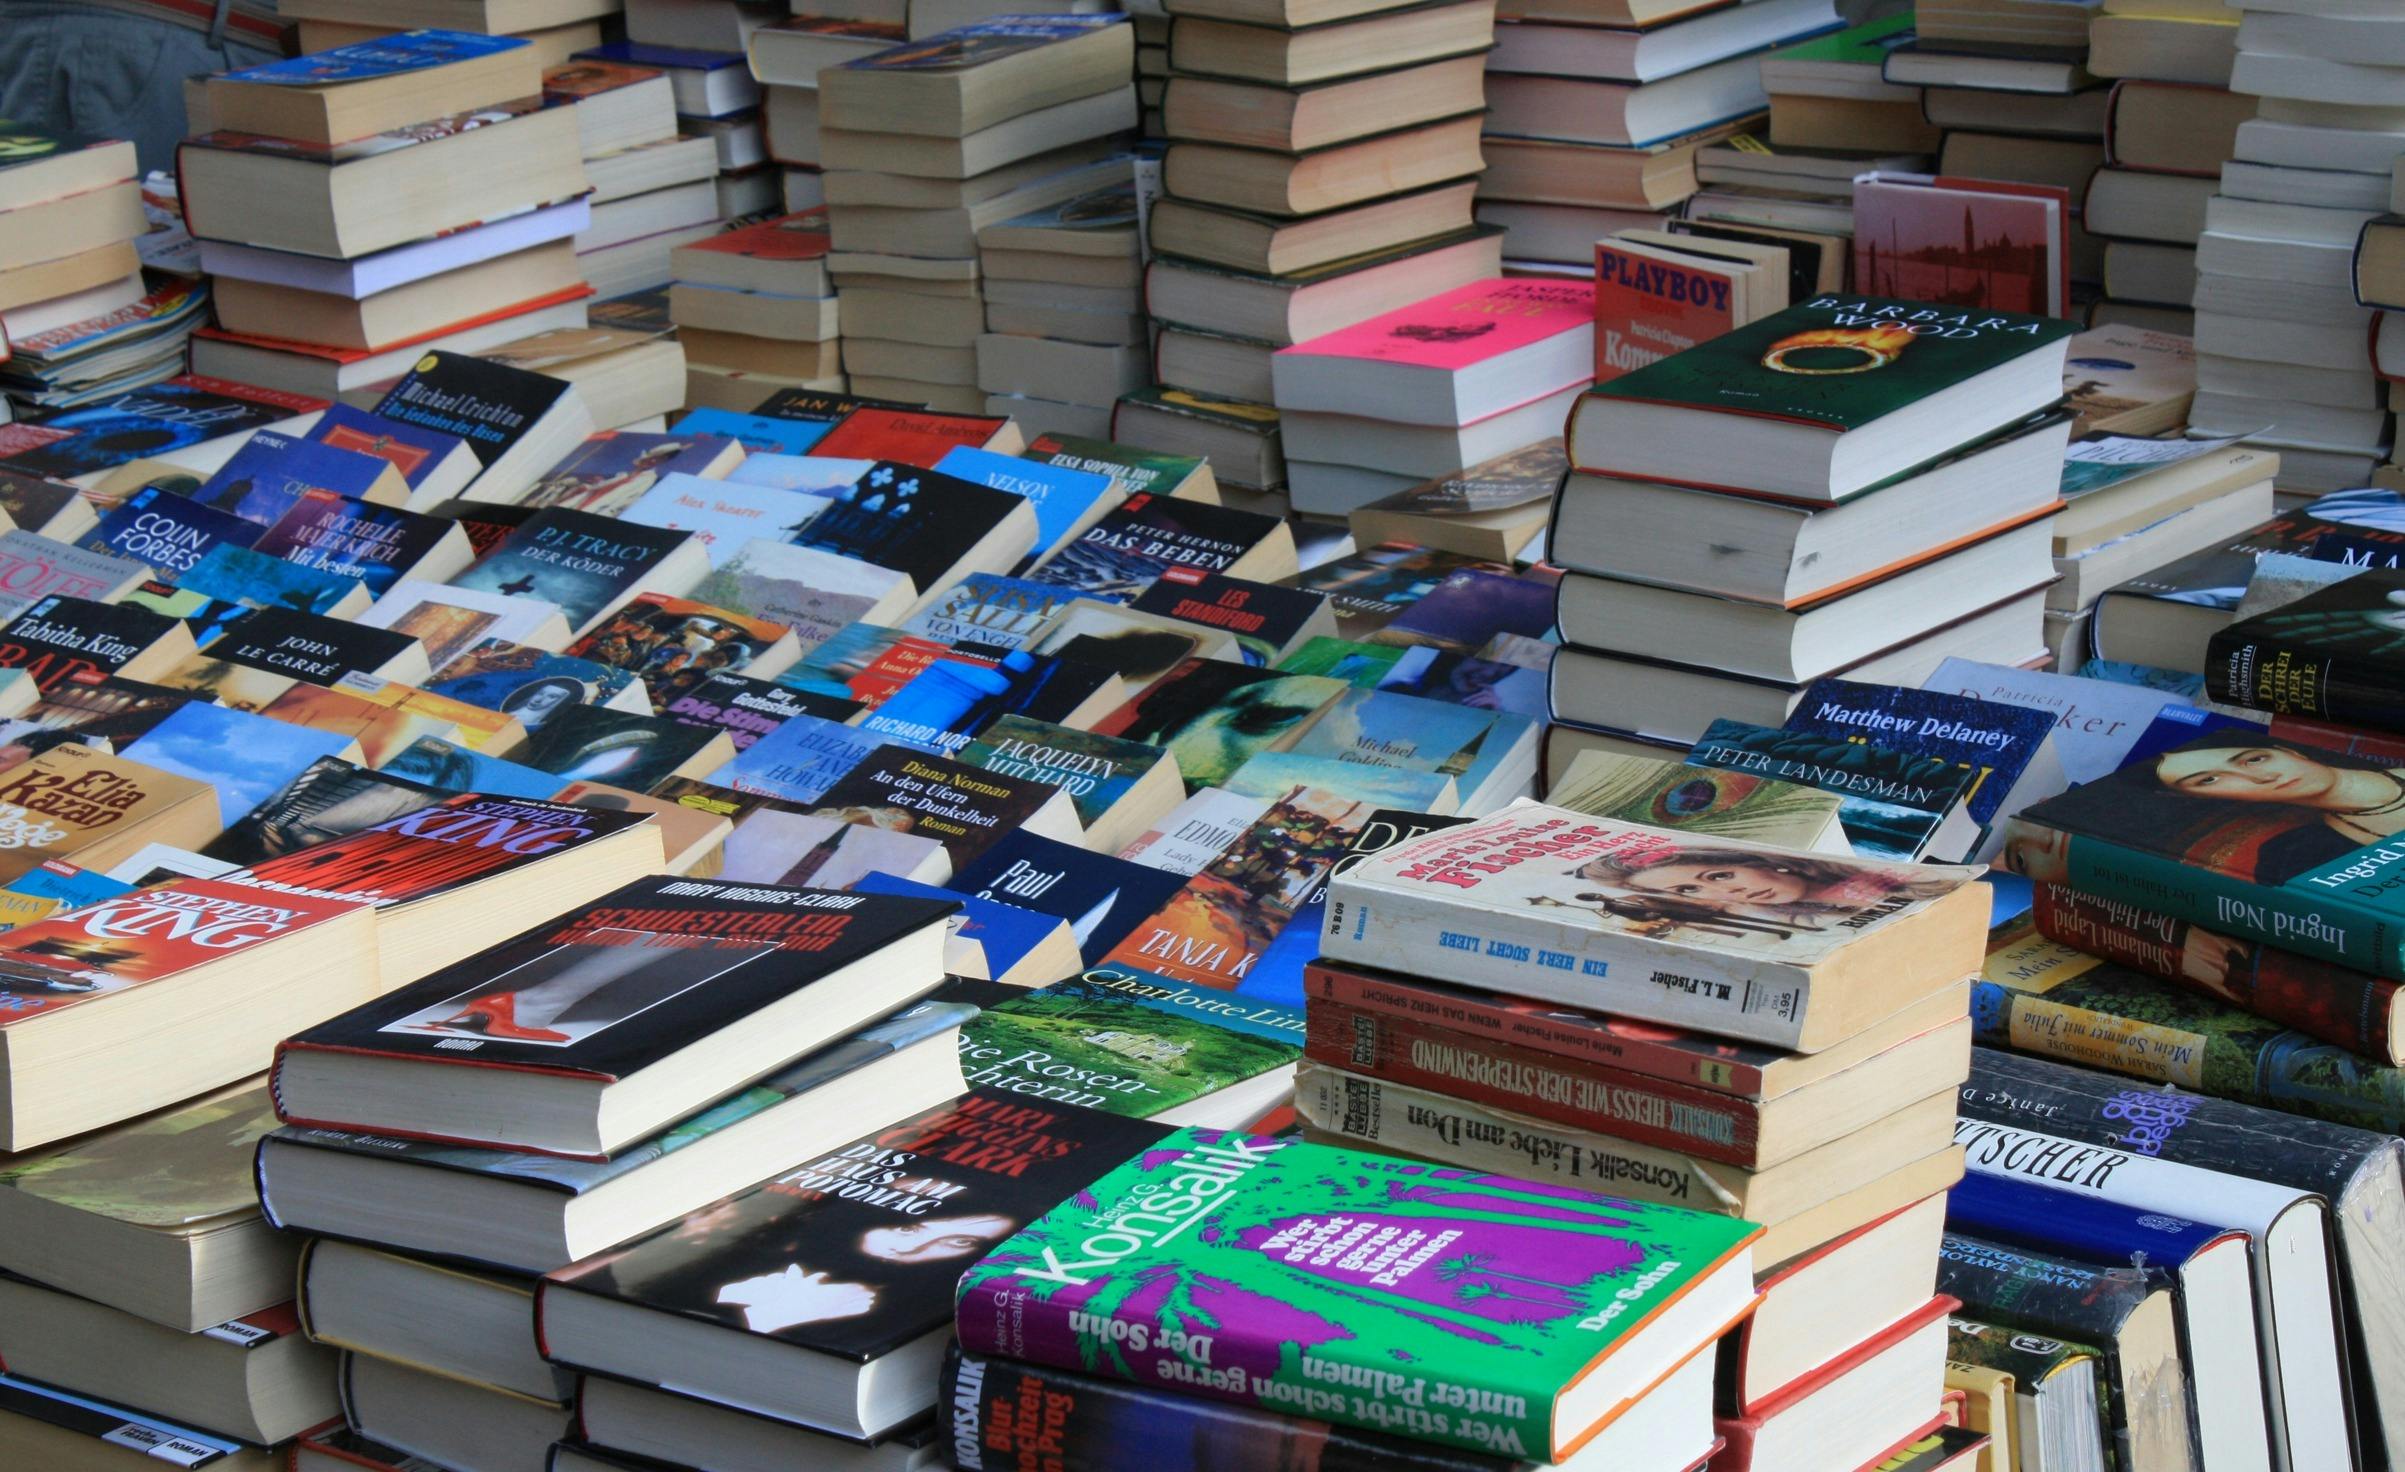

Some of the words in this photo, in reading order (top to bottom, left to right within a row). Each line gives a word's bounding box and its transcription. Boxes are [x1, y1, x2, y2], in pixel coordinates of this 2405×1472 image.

[1601, 251, 1729, 311] PLAYBOY
[1807, 298, 2041, 335] BARBARA
[1833, 314, 1980, 340] WOOD
[401, 381, 466, 411] Michael
[458, 396, 524, 428] Crichton
[783, 396, 827, 409] JAN
[1049, 453, 1082, 470] ELSA
[1128, 466, 1160, 482] VON
[982, 472, 1055, 501] NELSON
[135, 512, 210, 550] COLIN
[317, 511, 405, 545] ROCHELLE
[1126, 523, 1176, 541] PETER
[1179, 532, 1245, 554] HERNON
[112, 528, 203, 571] FORBES
[520, 546, 557, 562] DER
[560, 552, 626, 578] KÖDER
[572, 534, 658, 562] TRACY
[1082, 528, 1136, 551] DAS
[1142, 540, 1234, 570] BEBEN
[1171, 600, 1266, 632] STANDIFORD
[1216, 588, 1250, 607] LES
[10, 617, 87, 649] Tabitha
[81, 633, 138, 663] King
[276, 635, 339, 657] JOHN
[236, 644, 259, 659] LE
[265, 650, 341, 677] CARRÉ
[2228, 651, 2240, 697] Patricia
[767, 688, 797, 704] Gary
[2259, 662, 2274, 700] DER
[2275, 651, 2292, 714] SCHREI
[2289, 668, 2302, 704] DER
[2302, 663, 2318, 712] EULE
[668, 697, 717, 720] Die
[1813, 701, 1919, 737] Matthew
[1924, 718, 2016, 752] Delaney
[866, 715, 937, 742] RICHARD
[1352, 735, 1419, 759] Michael
[981, 756, 1096, 798] MITCHARD
[990, 738, 1122, 780] JACQUELYN
[1702, 744, 1774, 770] PETER
[1779, 761, 1935, 805] LANDESMAN
[53, 770, 146, 810] Elia
[870, 769, 888, 783] An
[892, 773, 921, 789] den
[925, 783, 969, 805] Ufern
[902, 760, 946, 784] Diana
[949, 773, 1011, 799] Norman
[0, 769, 124, 831] Kazan
[463, 802, 597, 826] STEPHEN
[887, 790, 915, 808] der
[916, 799, 1000, 830] Dunkelheit
[365, 808, 594, 855] KING
[918, 816, 967, 836] Roman
[1163, 848, 1196, 864] Lady
[1396, 843, 1487, 881] Marie
[1478, 818, 1570, 849] Louise
[1426, 825, 1611, 889] Fischer
[2309, 848, 2404, 888] Ingrid
[657, 881, 723, 898] MARY
[715, 887, 866, 910] HIGGINS-CLARK
[990, 860, 1066, 900] Paul
[48, 898, 292, 948] KING
[143, 890, 308, 925] STEPHEN
[1353, 906, 1368, 941] Roman
[1838, 897, 1913, 929] ROMAN
[2217, 895, 2266, 932] Noll
[1331, 923, 1341, 935] 76
[1440, 930, 1480, 953] LIEBE
[2053, 908, 2096, 945] Lapid
[2145, 913, 2177, 944] Der
[2273, 911, 2347, 955] Ingrid
[1137, 928, 1231, 972] TANJA
[1486, 940, 1532, 962] SUCHT
[1537, 952, 1576, 971] HERZ
[1582, 960, 1609, 977] EIN
[2008, 956, 2057, 981] Mein
[2099, 926, 2173, 975] Shulamit
[1361, 988, 1407, 1010] SPRICHT
[1650, 970, 1698, 994] Fischer
[1082, 969, 1243, 1022] Charlotte
[1241, 1004, 1307, 1034] Lin
[1410, 999, 1440, 1016] HERZ
[1443, 1007, 1464, 1021] DAS
[1777, 992, 1792, 1018] 3,95
[1468, 1014, 1501, 1030] WENN
[1513, 1022, 1552, 1042] Fischer
[1553, 1031, 1590, 1048] Louise
[2022, 1010, 2061, 1037] Julia
[2062, 1023, 2087, 1044] mit
[2089, 1025, 2149, 1056] Sommer
[1592, 1040, 1623, 1057] Marie
[2045, 1038, 2124, 1067] WOODHOUSE
[2125, 1053, 2167, 1076] SARAH
[2151, 1038, 2194, 1065] Mein
[999, 1050, 1161, 1095] Rosen-
[1411, 1039, 1535, 1098] STEPPENWIND
[1537, 1069, 1572, 1103] DER
[955, 1095, 1067, 1132] MARY
[1575, 1079, 1608, 1113] WIE
[1613, 1090, 1665, 1127] HEISS
[1984, 1091, 2059, 1117] Janice
[912, 1110, 1083, 1160] HIGGINS
[1408, 1104, 1461, 1147] Don
[1466, 1118, 1505, 1146] am
[1670, 1102, 1734, 1145] KONSALIK
[842, 1143, 916, 1168] DAS
[875, 1126, 1036, 1178] CLARK
[1511, 1131, 1582, 1180] Liebe
[786, 1171, 942, 1216] POTOMAC
[817, 1157, 905, 1187] HAUS
[900, 1178, 967, 1202] AM
[1589, 1155, 1688, 1201] Konsalik
[1014, 1137, 1288, 1287] Konsalik
[1084, 1190, 1143, 1232] Heinz
[1132, 1180, 1165, 1201] G.
[1259, 1218, 1318, 1250] Wer
[1284, 1216, 1354, 1263] stirbt
[1309, 1222, 1379, 1266] schon
[1336, 1226, 1402, 1271] gerne
[1360, 1229, 1427, 1274] unter
[1576, 1306, 1618, 1334] Der
[1624, 1259, 1684, 1305] Sohn
[2014, 1268, 2085, 1289] NANCY
[994, 1310, 1010, 1353] Heinz
[1011, 1291, 1027, 1358] Konsalik
[1068, 1309, 1150, 1352] Sohn
[1156, 1330, 1213, 1365] Der
[1156, 1357, 1248, 1395] gerne
[1302, 1357, 1425, 1403] Palmen
[1252, 1377, 1347, 1414] schon
[1429, 1387, 1528, 1421] unter
[953, 1357, 987, 1472] KONSALIK
[1038, 1391, 1074, 1455] Prag
[1355, 1401, 1452, 1437] stirbt
[167, 1441, 210, 1458] ROMAN
[1454, 1419, 1528, 1457] Wer
